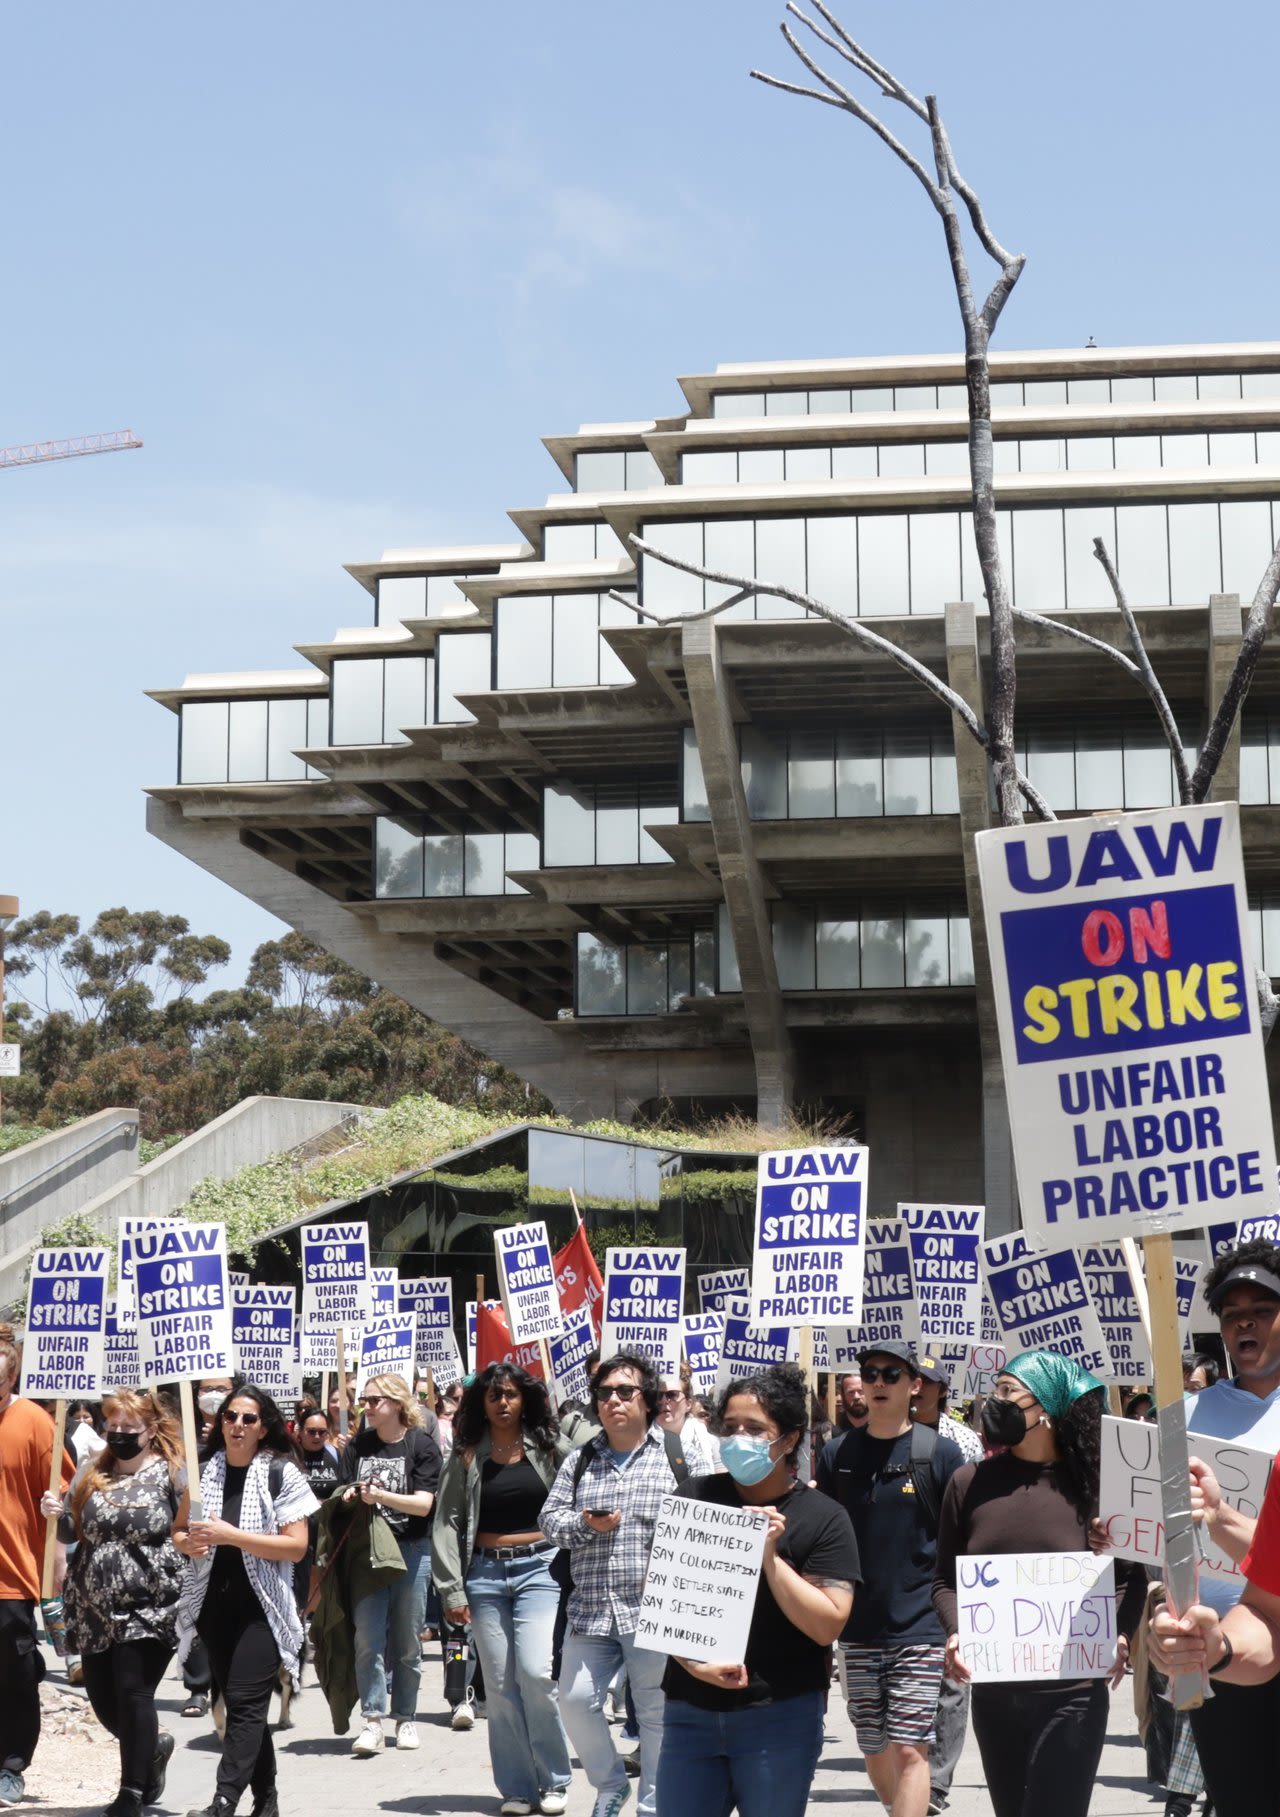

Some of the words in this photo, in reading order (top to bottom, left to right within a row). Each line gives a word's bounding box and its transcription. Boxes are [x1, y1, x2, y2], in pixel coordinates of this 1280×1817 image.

[1004, 817, 1222, 894] UAW
[1081, 900, 1172, 967] ON
[1023, 960, 1243, 1044] STRIKE
[1058, 1053, 1225, 1116] UNFAIR
[1073, 1106, 1223, 1167] LABOR
[768, 1153, 860, 1179] UAW
[1042, 1150, 1264, 1223] PRACTICE
[791, 1185, 828, 1211] ON
[762, 1213, 857, 1242] STRIKE
[902, 1209, 980, 1230] UAW
[135, 1229, 219, 1259] UAW
[307, 1226, 362, 1242] UAW
[502, 1227, 543, 1248] UAW
[323, 1246, 347, 1262] ON
[923, 1237, 954, 1257] ON
[38, 1253, 104, 1272] UAW
[517, 1249, 537, 1267] ON
[613, 1253, 680, 1270] UAW
[772, 1252, 843, 1272] UNFAIR
[160, 1261, 193, 1285] ON
[307, 1262, 365, 1280] STRIKE
[508, 1264, 552, 1289] STRIKE
[914, 1258, 976, 1280] TRIKE
[1016, 1261, 1051, 1290] ON
[53, 1279, 80, 1301] ON
[315, 1284, 358, 1297] UNFAIR
[401, 1282, 447, 1295] UAW
[630, 1277, 658, 1297] ON
[701, 1273, 745, 1292] UAW
[775, 1274, 838, 1294] LABOR
[864, 1274, 910, 1297] RIKE
[1088, 1274, 1114, 1295] ON
[140, 1284, 222, 1314] STRIKE
[234, 1290, 292, 1305] UAW
[318, 1297, 356, 1310] LABOR
[517, 1290, 550, 1308] UNFAIR
[917, 1286, 966, 1301] NFAIR
[1001, 1278, 1083, 1323] STRIKE
[414, 1298, 434, 1311] ON
[522, 1305, 550, 1321] LABOR
[609, 1298, 678, 1318] STRIKE
[759, 1296, 853, 1317] PRACTICE
[920, 1303, 963, 1318] ABOR
[31, 1304, 100, 1326] STRIKE
[250, 1310, 274, 1325] ON
[309, 1309, 366, 1323] PRACTICE
[364, 1316, 412, 1334] UAW
[417, 1311, 449, 1326] RIKE
[151, 1315, 213, 1337] UNFAIR
[233, 1326, 291, 1342] STRIKE
[415, 1330, 444, 1340] NFAIR
[517, 1317, 560, 1338] PRACTICE
[616, 1326, 667, 1341] UNFAIR
[745, 1328, 770, 1342] ON
[847, 1325, 902, 1343] LABOR
[921, 1321, 975, 1336] ACTICE
[1019, 1315, 1082, 1348] UNFAIR
[38, 1337, 88, 1352] UNFAIR
[155, 1335, 211, 1356] LABOR
[376, 1333, 397, 1348] ON
[416, 1342, 442, 1352] ABOR
[562, 1332, 579, 1352] ON
[240, 1346, 283, 1358] UNFAIR
[311, 1348, 336, 1357] LABO
[361, 1344, 412, 1366] STRIKE
[416, 1352, 451, 1363] ACTICE
[554, 1340, 593, 1375] STRIKE
[725, 1340, 786, 1362] STRIKE
[39, 1355, 84, 1371] LABOR
[145, 1353, 227, 1377] PRACTICE
[241, 1360, 280, 1371] LABOR
[303, 1358, 350, 1367] PRACTIE
[367, 1363, 404, 1377] UNFAIR
[26, 1374, 96, 1390] PRACTICE
[662, 1498, 689, 1519] SAY
[693, 1504, 765, 1531] GENOCIDE
[657, 1522, 680, 1540] SAY
[684, 1528, 753, 1552] APARTHEID
[652, 1546, 674, 1562] SAY
[680, 1552, 758, 1576] COLONIZATION
[960, 1561, 999, 1588] UC
[1016, 1557, 1100, 1587] NEEDS
[647, 1572, 667, 1586] SAY
[672, 1576, 713, 1593] SETTLER
[716, 1587, 745, 1600] STATE
[643, 1594, 663, 1610] SAY
[670, 1599, 724, 1618] SETTLERS
[961, 1602, 995, 1634] TO
[1013, 1595, 1117, 1639] DIVEST
[638, 1619, 658, 1635] SAY
[663, 1626, 717, 1647] MURDERED
[963, 1642, 1004, 1673] FREE
[1012, 1642, 1108, 1673] PALESTINE
